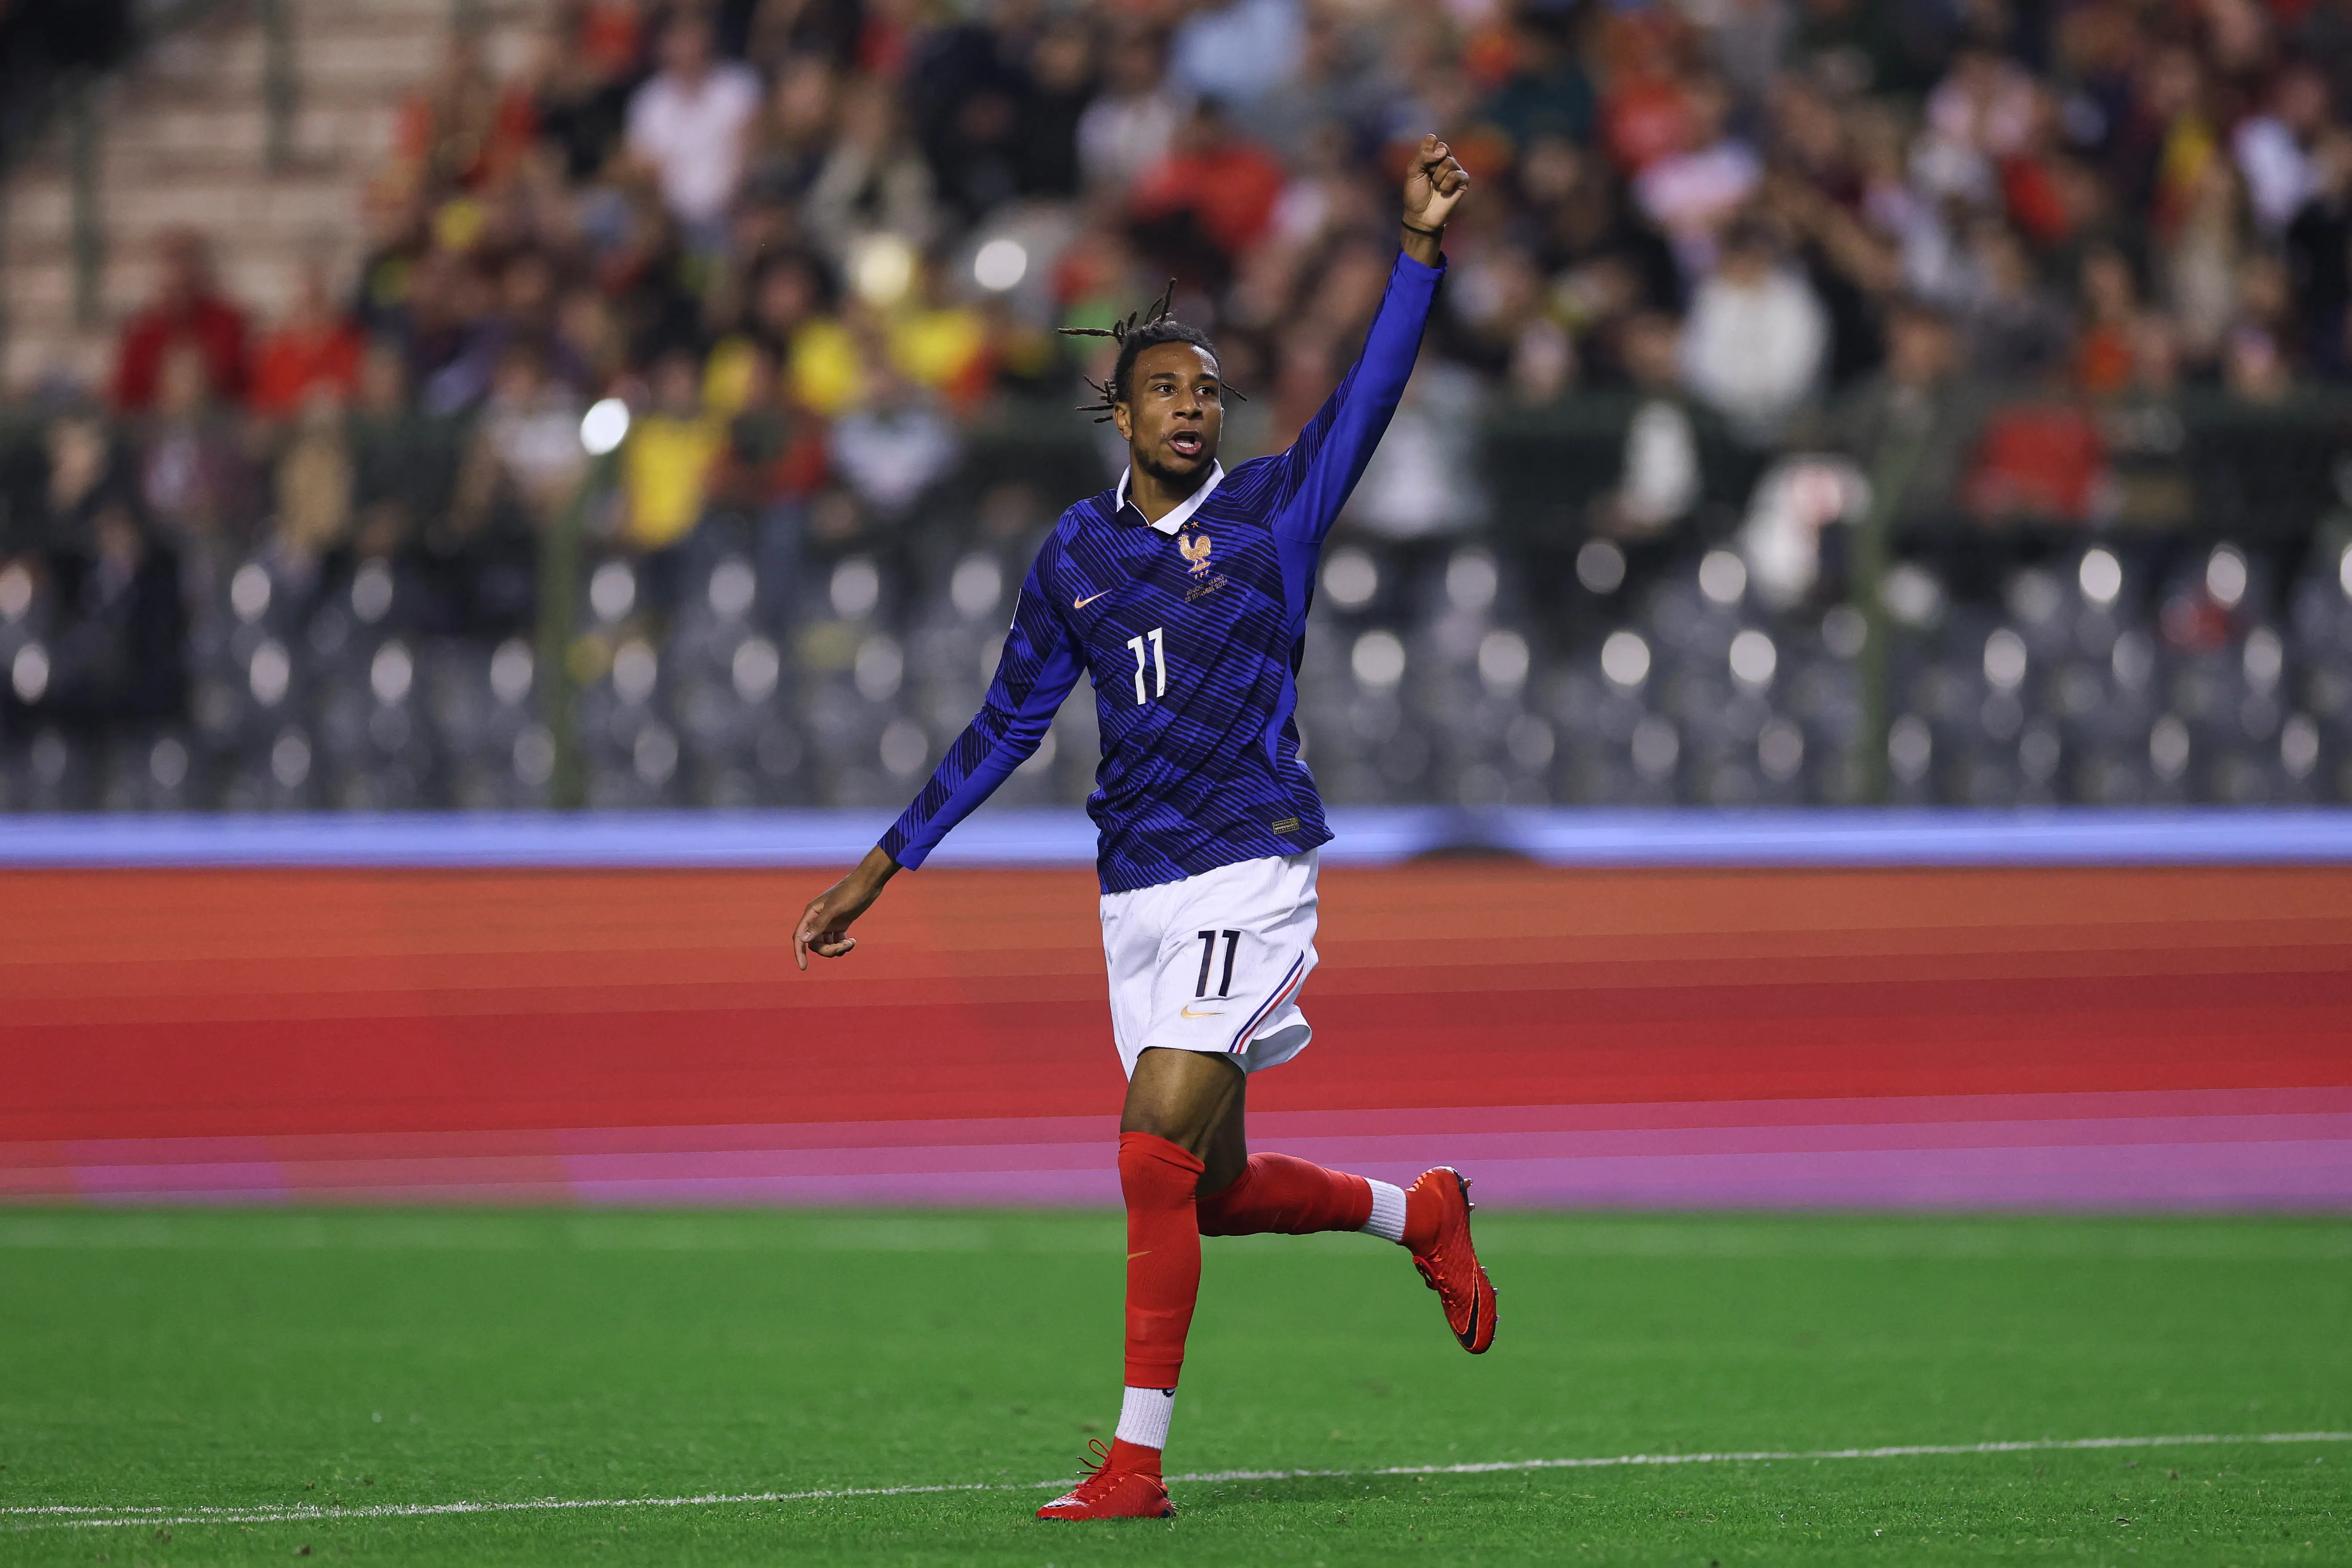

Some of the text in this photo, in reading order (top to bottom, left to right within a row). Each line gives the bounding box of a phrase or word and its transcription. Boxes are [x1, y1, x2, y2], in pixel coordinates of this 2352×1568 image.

[1194, 570, 1209, 580] FFF
[1208, 574, 1224, 586] FRANCE
[1192, 585, 1215, 600] SEPTEMBRE
[1127, 627, 1166, 705] 11
[1195, 929, 1241, 998] 11
